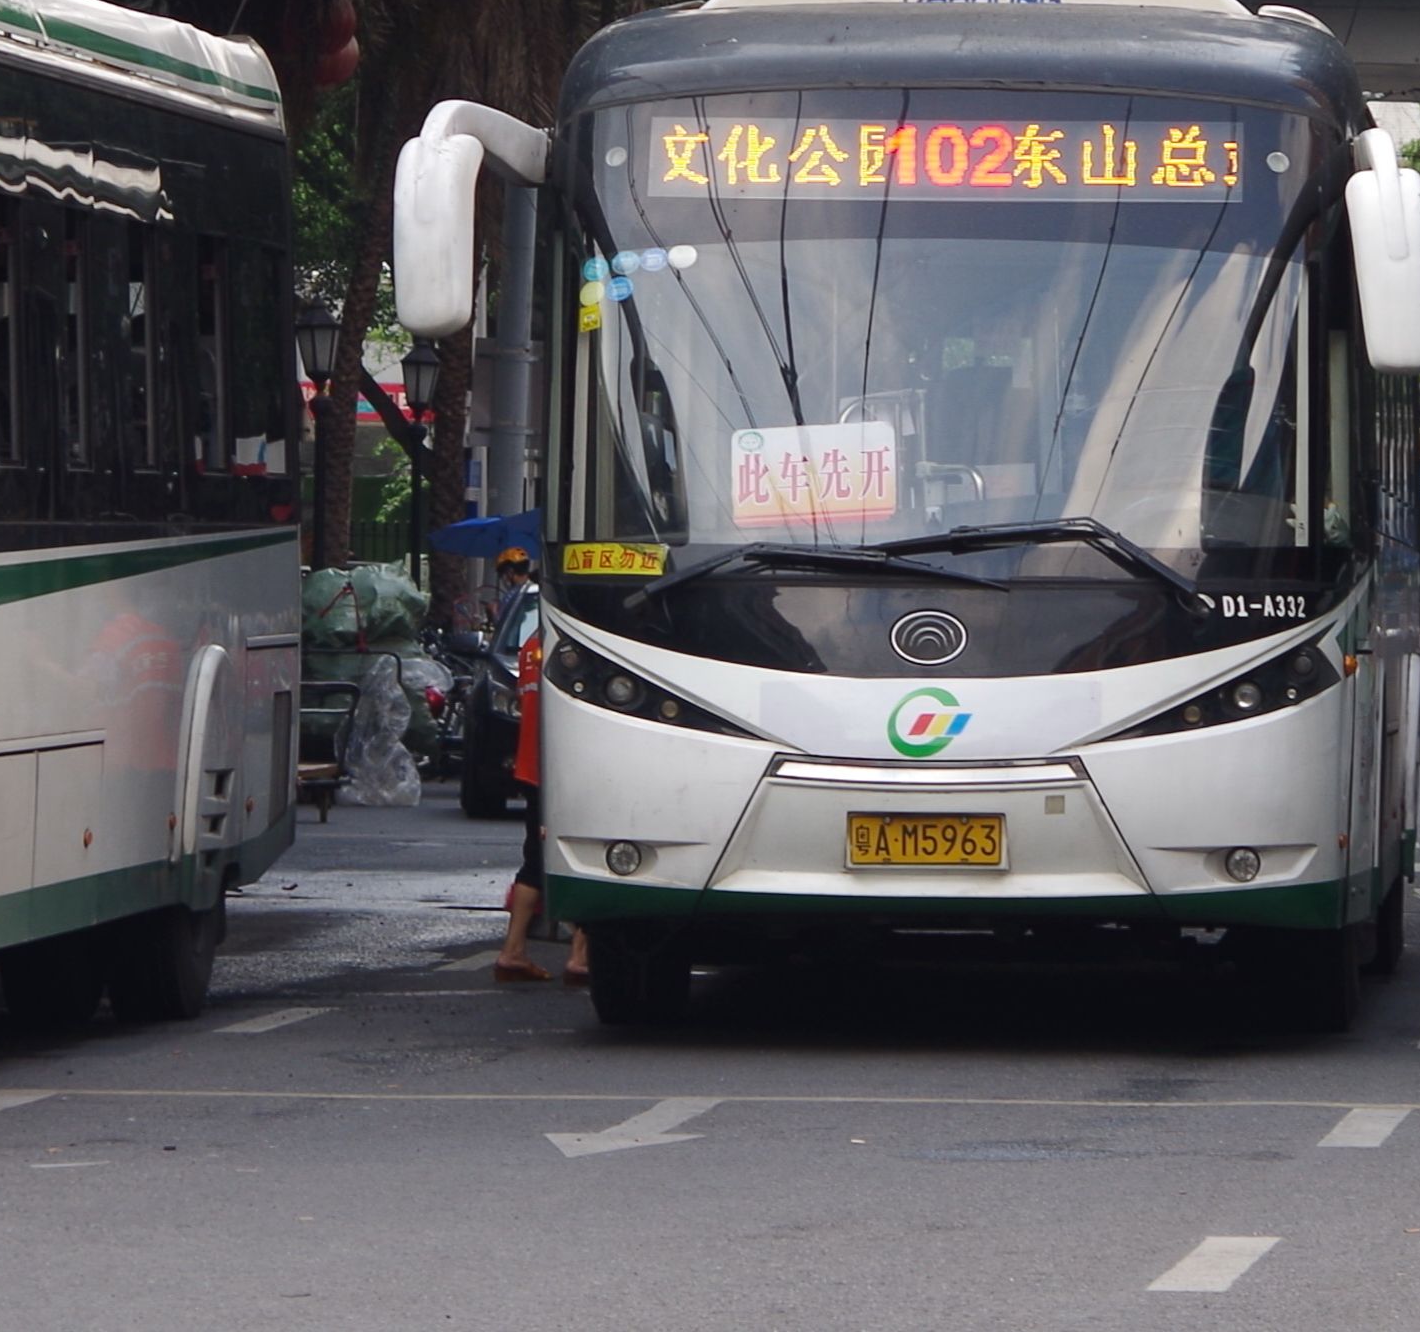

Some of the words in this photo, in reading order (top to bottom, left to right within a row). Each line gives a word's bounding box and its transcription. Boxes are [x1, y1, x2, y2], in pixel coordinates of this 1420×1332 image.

[885, 124, 1014, 187] 102
[738, 446, 890, 504] 此车先开
[582, 549, 658, 569] 盲区勿近
[1222, 595, 1306, 618] D1-A332
